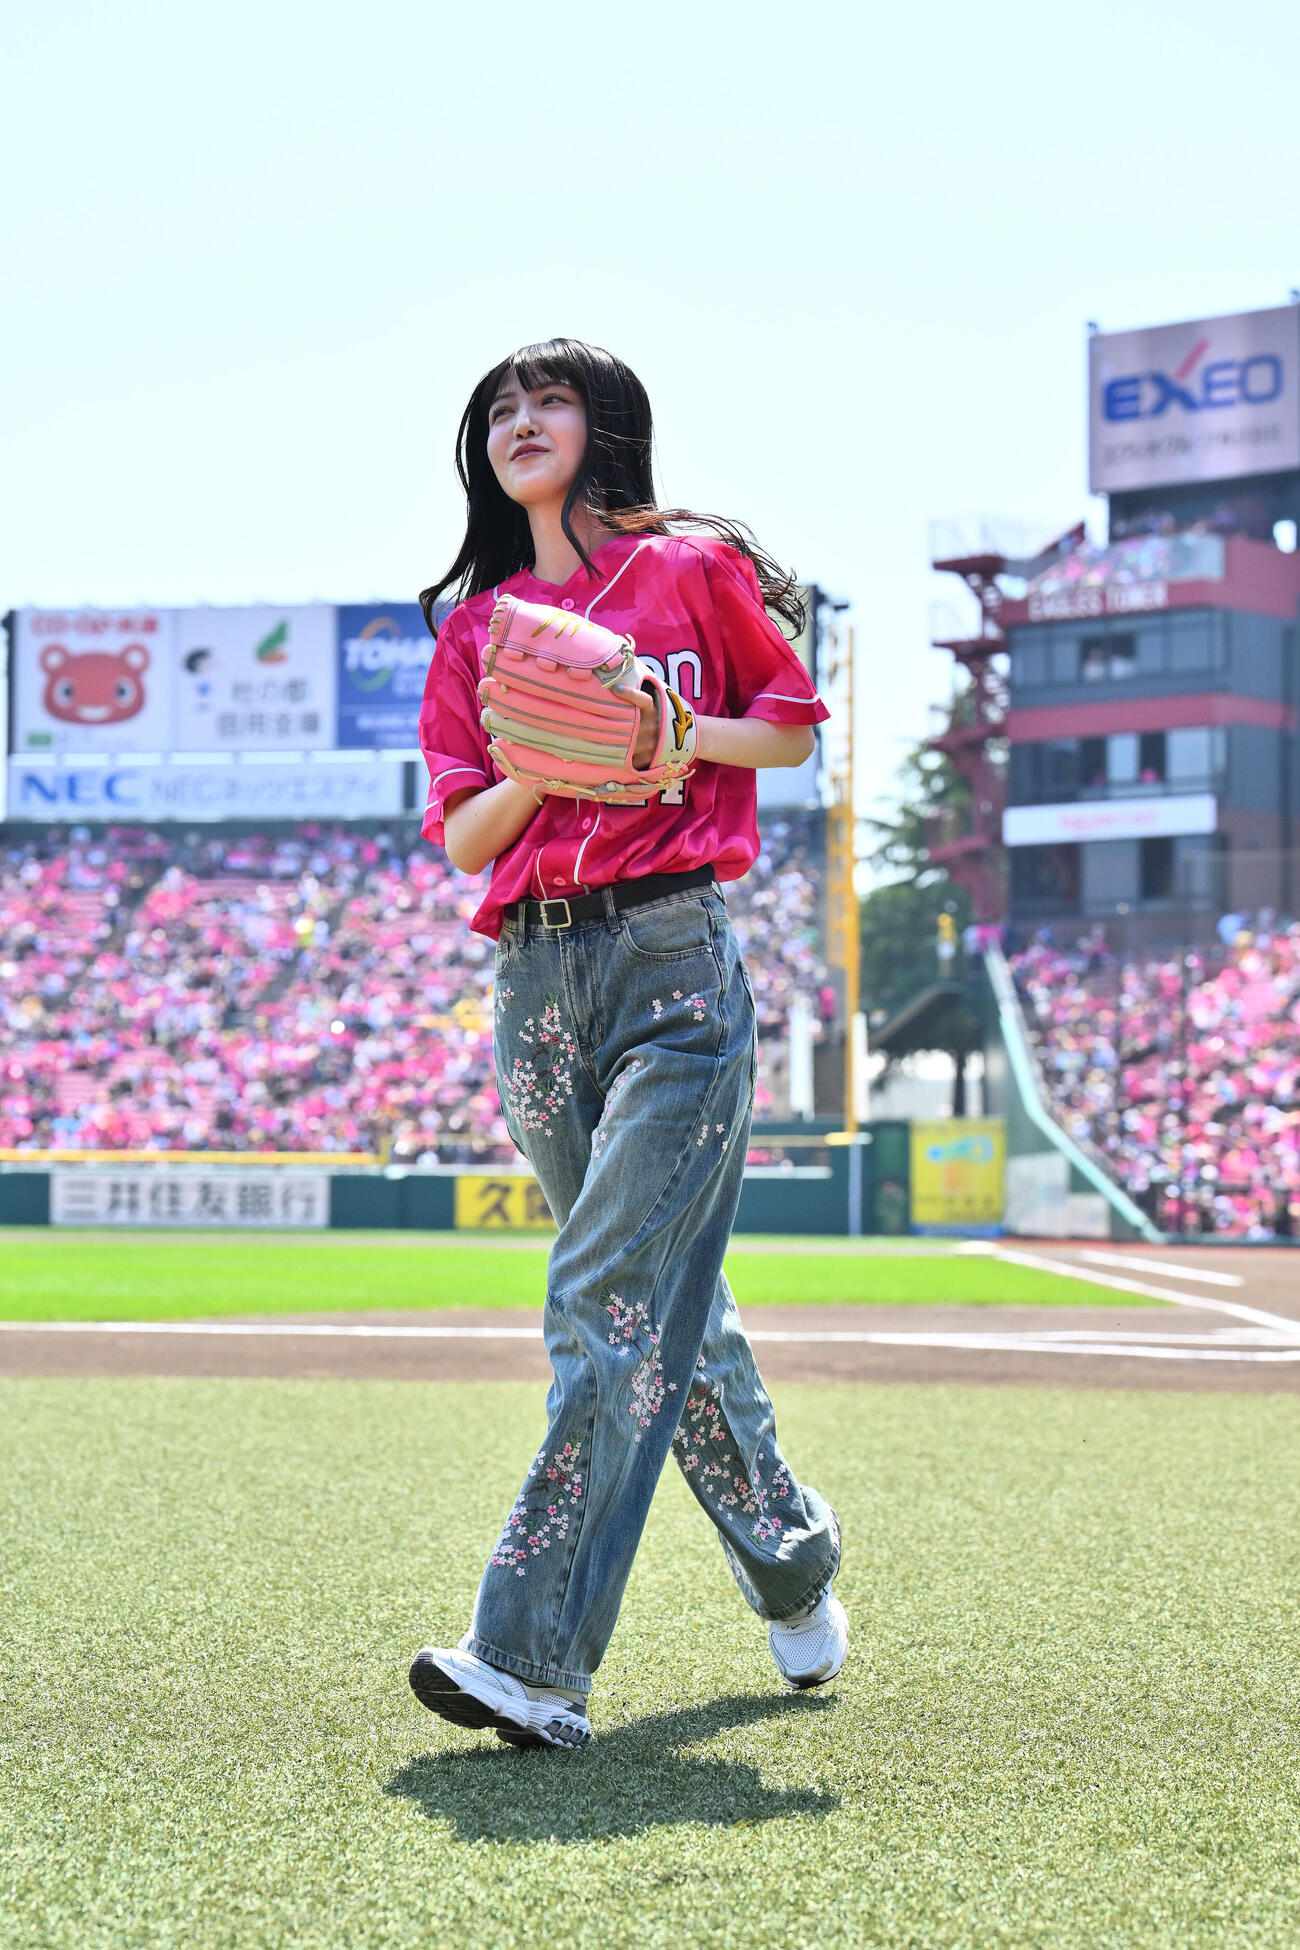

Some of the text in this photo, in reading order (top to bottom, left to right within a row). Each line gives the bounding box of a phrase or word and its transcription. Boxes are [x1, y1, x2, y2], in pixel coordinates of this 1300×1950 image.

[1103, 338, 1284, 422] EXEO
[20, 771, 137, 806] NEC
[63, 1179, 317, 1221] 三井住友銀行
